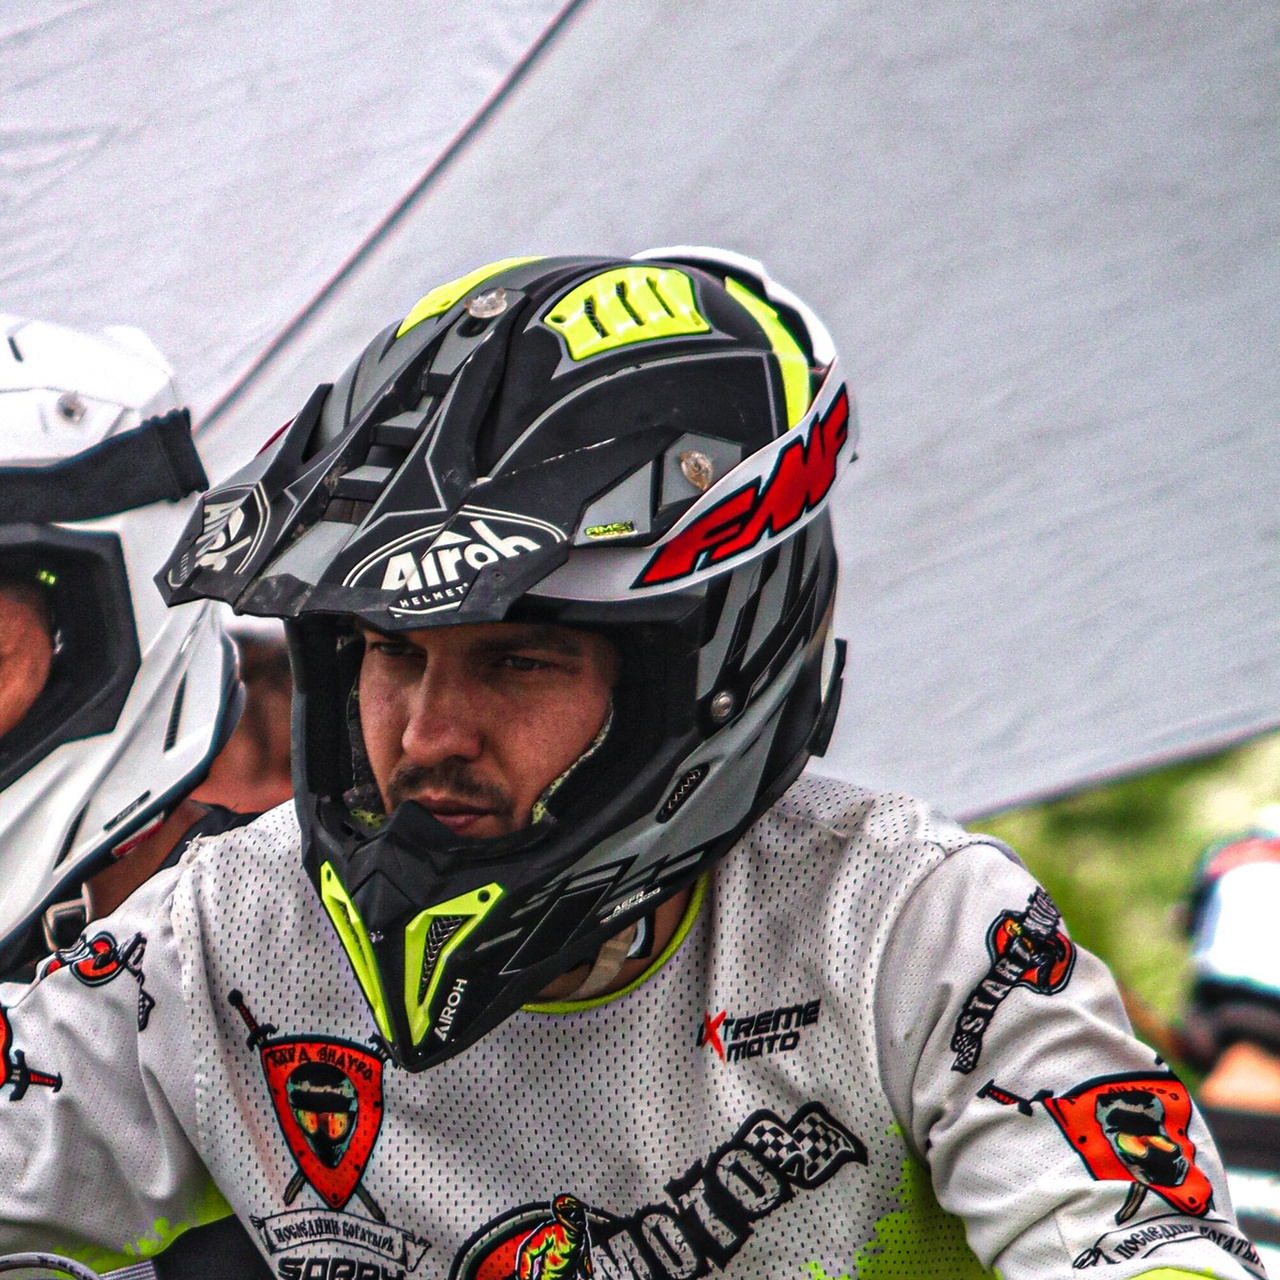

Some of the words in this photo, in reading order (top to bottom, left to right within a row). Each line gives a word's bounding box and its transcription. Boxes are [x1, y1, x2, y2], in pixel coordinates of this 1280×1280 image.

[630, 383, 849, 589] FMF
[434, 978, 468, 1042] AIROH
[727, 1031, 800, 1062] MOTO
